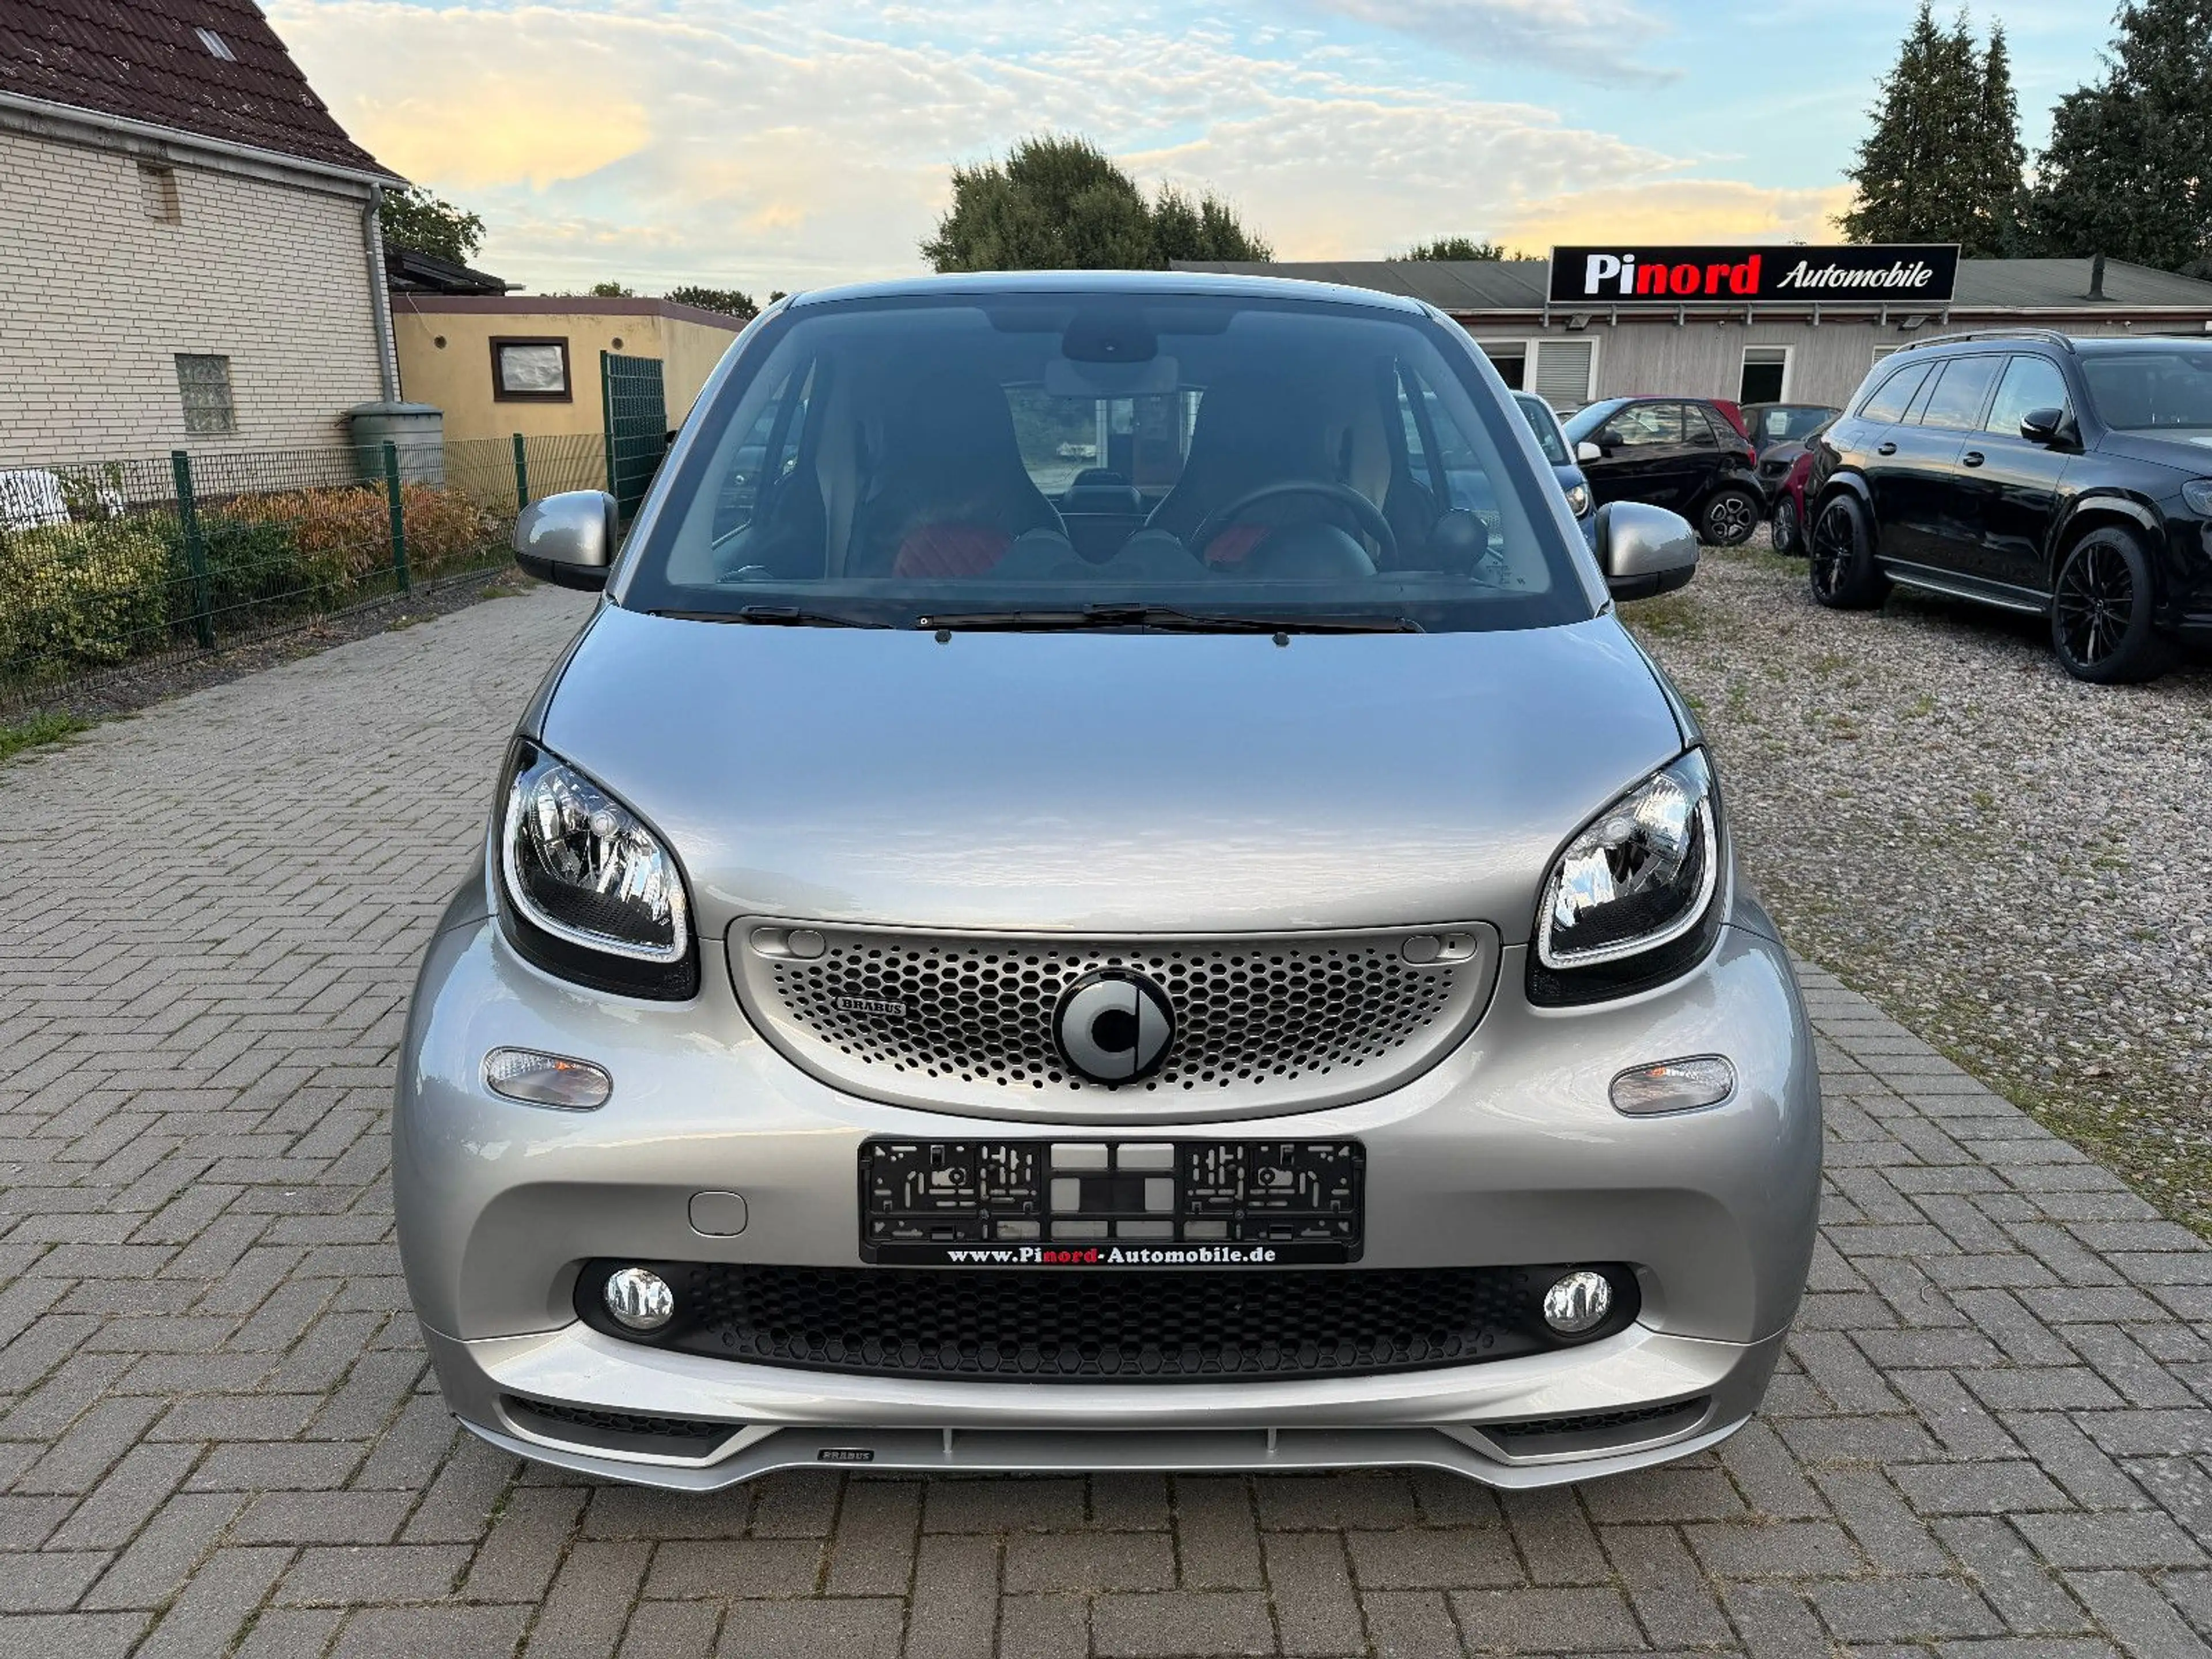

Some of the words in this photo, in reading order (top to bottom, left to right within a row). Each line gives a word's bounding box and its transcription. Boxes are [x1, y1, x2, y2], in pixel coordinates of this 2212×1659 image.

[1584, 254, 1761, 294] Pinord
[1777, 260, 1933, 288] Automobile
[842, 999, 902, 1014] BRABUS
[947, 1247, 1276, 1263] www.Pinord-Automobile.de
[822, 1450, 870, 1460] BRABUS
